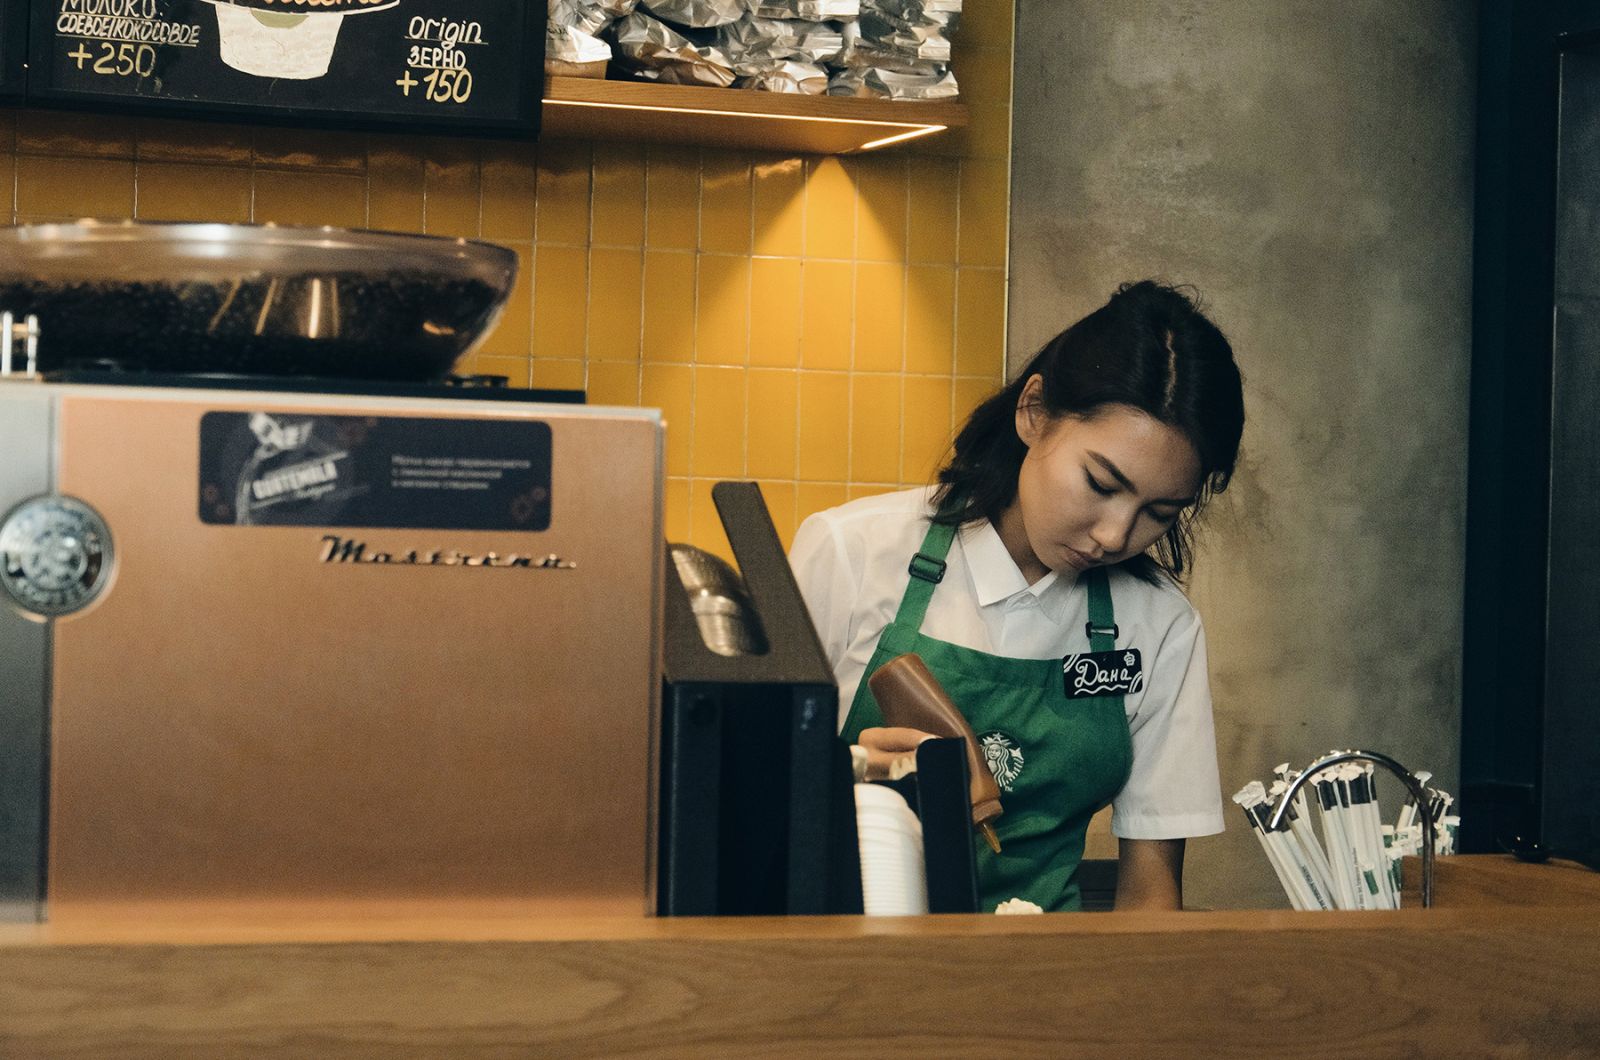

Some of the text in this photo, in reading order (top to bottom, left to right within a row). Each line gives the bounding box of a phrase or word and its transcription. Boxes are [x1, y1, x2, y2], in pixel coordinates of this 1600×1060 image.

[68, 41, 157, 78] +250
[406, 45, 467, 71] ЗЕРНО
[395, 68, 473, 103] +150
[1074, 658, 1132, 688] Дана
